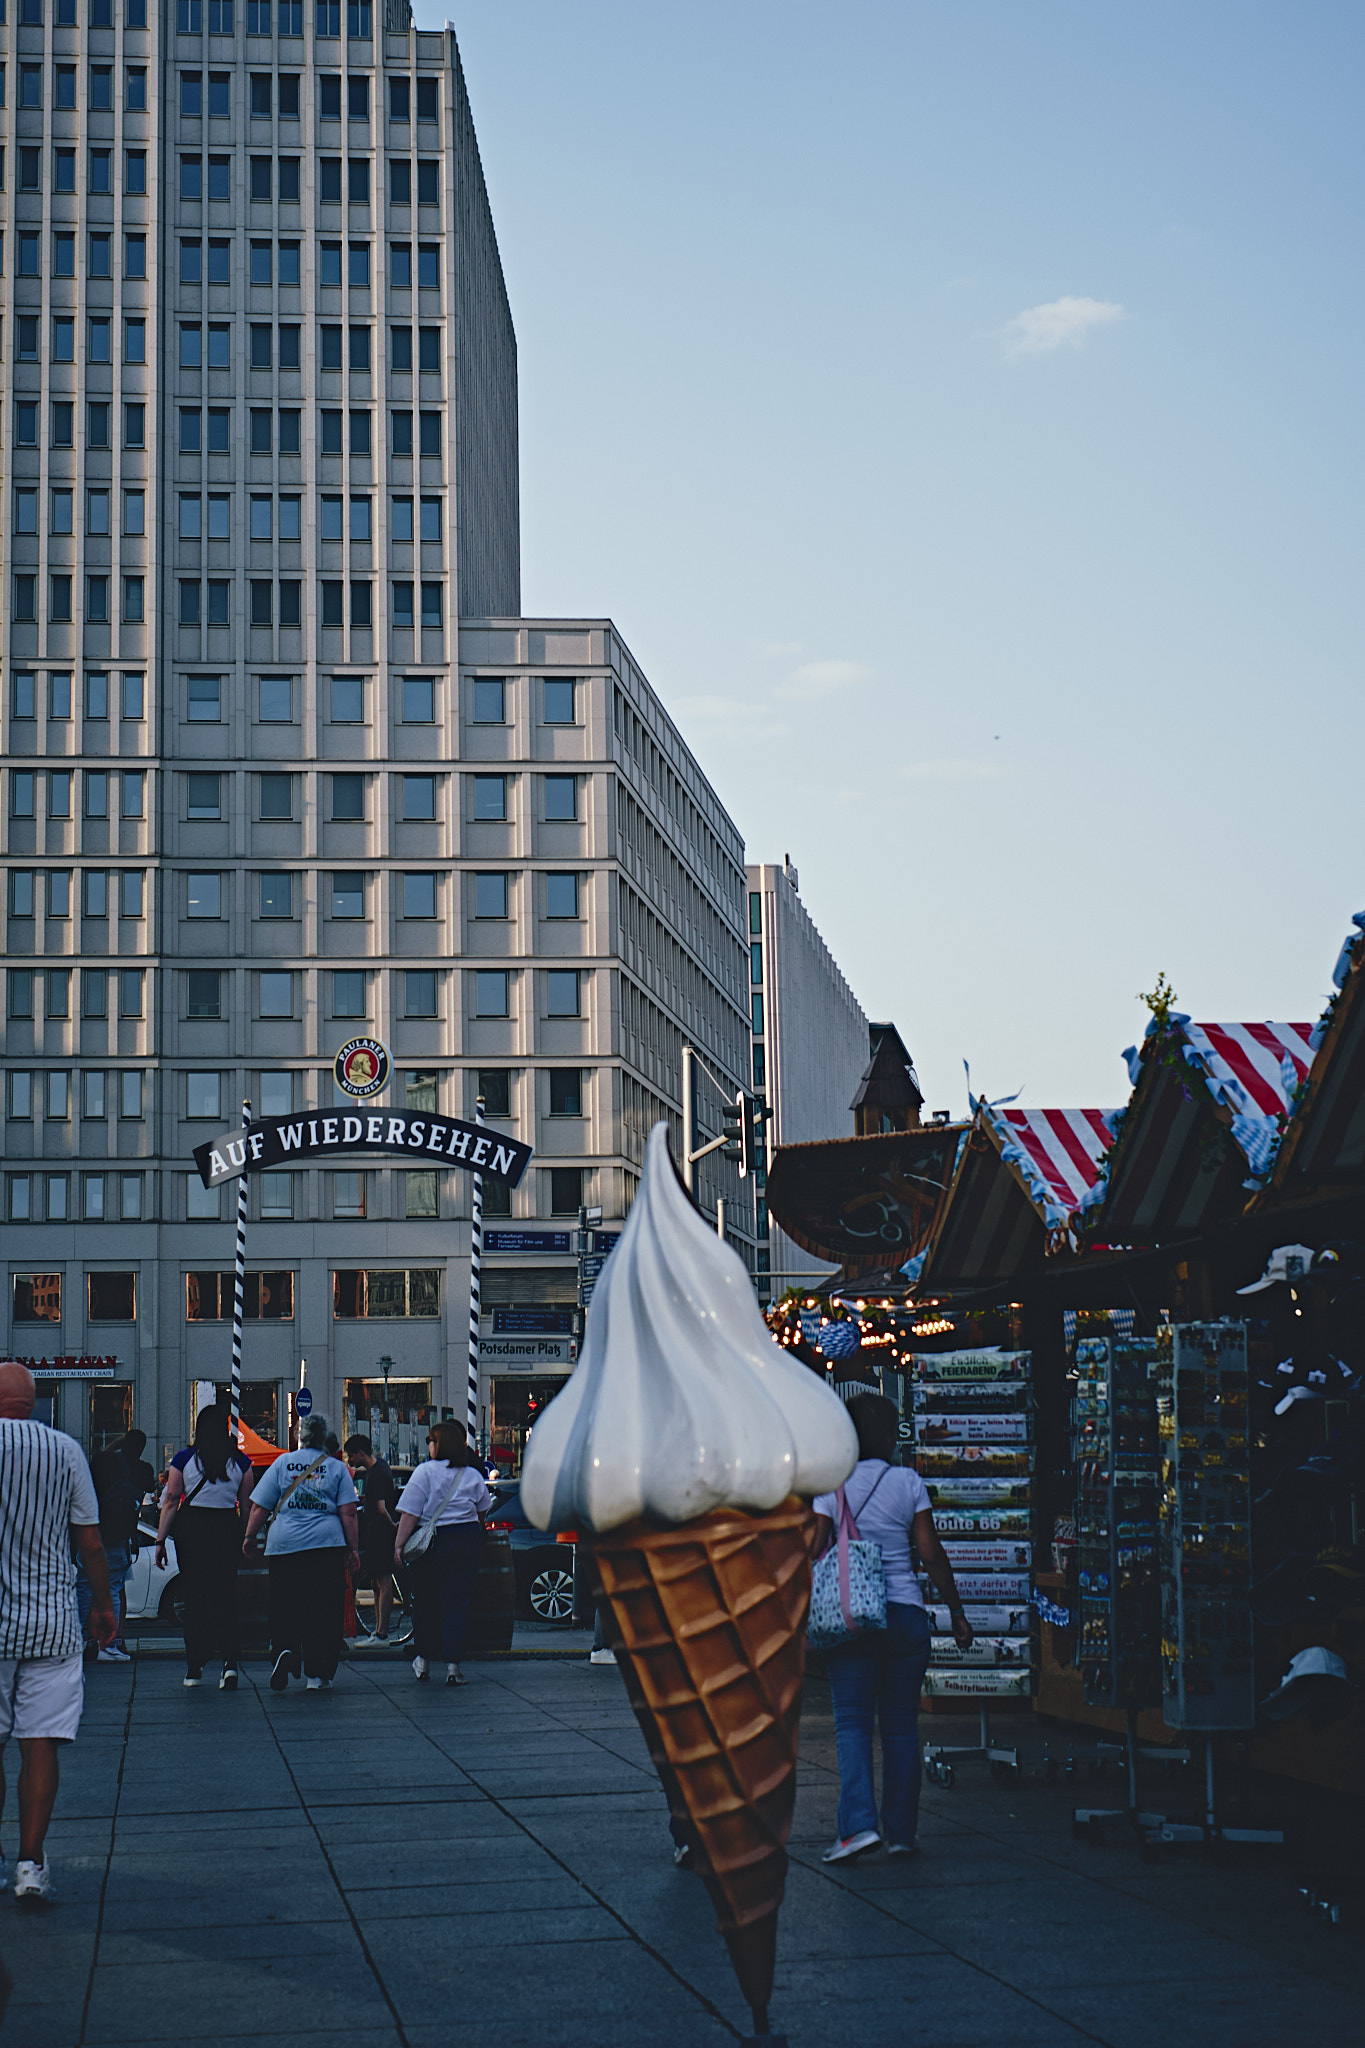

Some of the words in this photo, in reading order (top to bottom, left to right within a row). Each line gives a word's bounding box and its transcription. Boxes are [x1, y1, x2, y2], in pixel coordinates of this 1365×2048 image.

[339, 1039, 385, 1061] PAULANER
[209, 1132, 265, 1177] AUF
[277, 1116, 518, 1176] WIEDERSEHEN
[480, 1342, 536, 1354] Potsdamer
[538, 1342, 561, 1357] Platz
[54, 1356, 117, 1369] BHAVAN
[951, 1355, 989, 1366] Endlich
[94, 1369, 112, 1377] CHAIN
[942, 1366, 997, 1376] FEIERABEND
[898, 1421, 912, 1439] S
[288, 1501, 327, 1511] GANDER
[979, 1518, 1001, 1531] 66
[955, 1580, 976, 1588] Jetzt
[981, 1580, 1007, 1588] darfst
[956, 1589, 972, 1597] ich
[944, 1680, 998, 1693] Selbstpflücker
